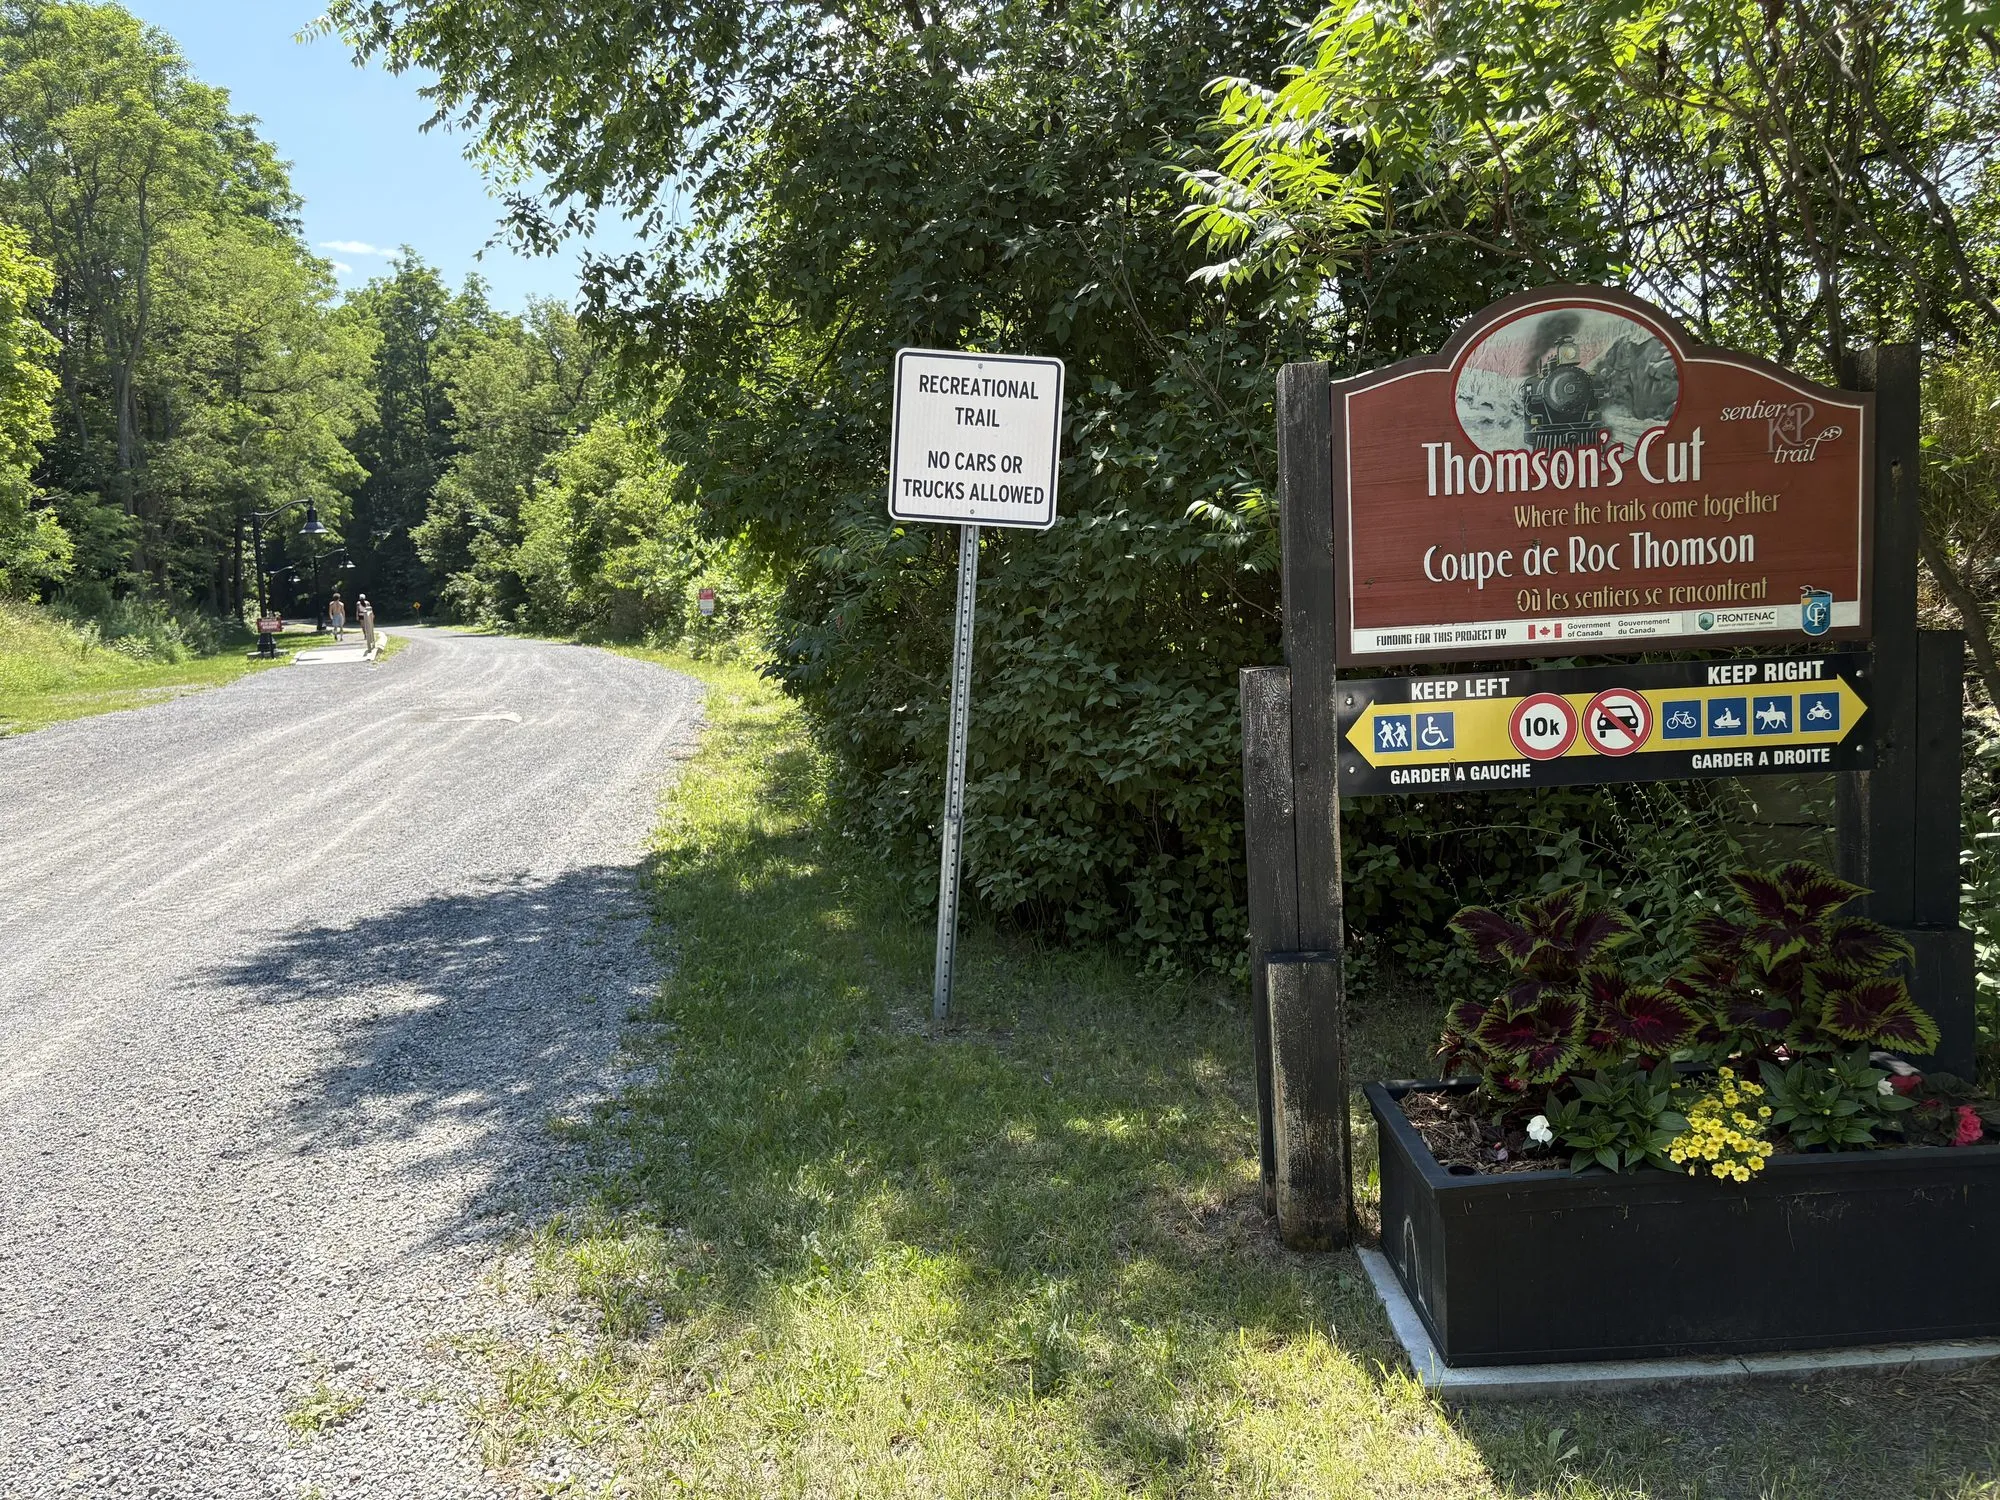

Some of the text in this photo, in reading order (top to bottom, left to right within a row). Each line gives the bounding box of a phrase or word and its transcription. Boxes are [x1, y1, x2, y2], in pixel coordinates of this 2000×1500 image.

[919, 374, 1039, 400] RECREATIONAL
[955, 406, 1000, 427] TRAIL
[1720, 400, 1786, 421] sentier
[1774, 433, 1827, 464] trail
[928, 450, 1023, 474] NO CARS OR
[1421, 425, 1706, 497] Thomson's Cut
[903, 478, 1045, 505] TRUCKS ALLOWED
[1514, 489, 1781, 529] Where the trails come together
[1423, 531, 1755, 590] Coupe de Roc Thomson
[1517, 576, 1768, 612] Où les sentiers se rencontrent
[1567, 621, 1611, 630] Government
[1617, 618, 1671, 627] Gouvernement
[1716, 611, 1776, 623] FRONTENAC
[1376, 628, 1507, 647] FUNDING FOR THIS PROJECT BY
[1576, 630, 1603, 638] Canada
[1628, 626, 1656, 634] Canada
[1707, 660, 1825, 685] KEEP RIGHT
[1411, 677, 1510, 701] KEEP LEFT
[1692, 748, 1831, 769] GARDER A DROITE
[1390, 763, 1531, 785] GARDER A GAUCHE
